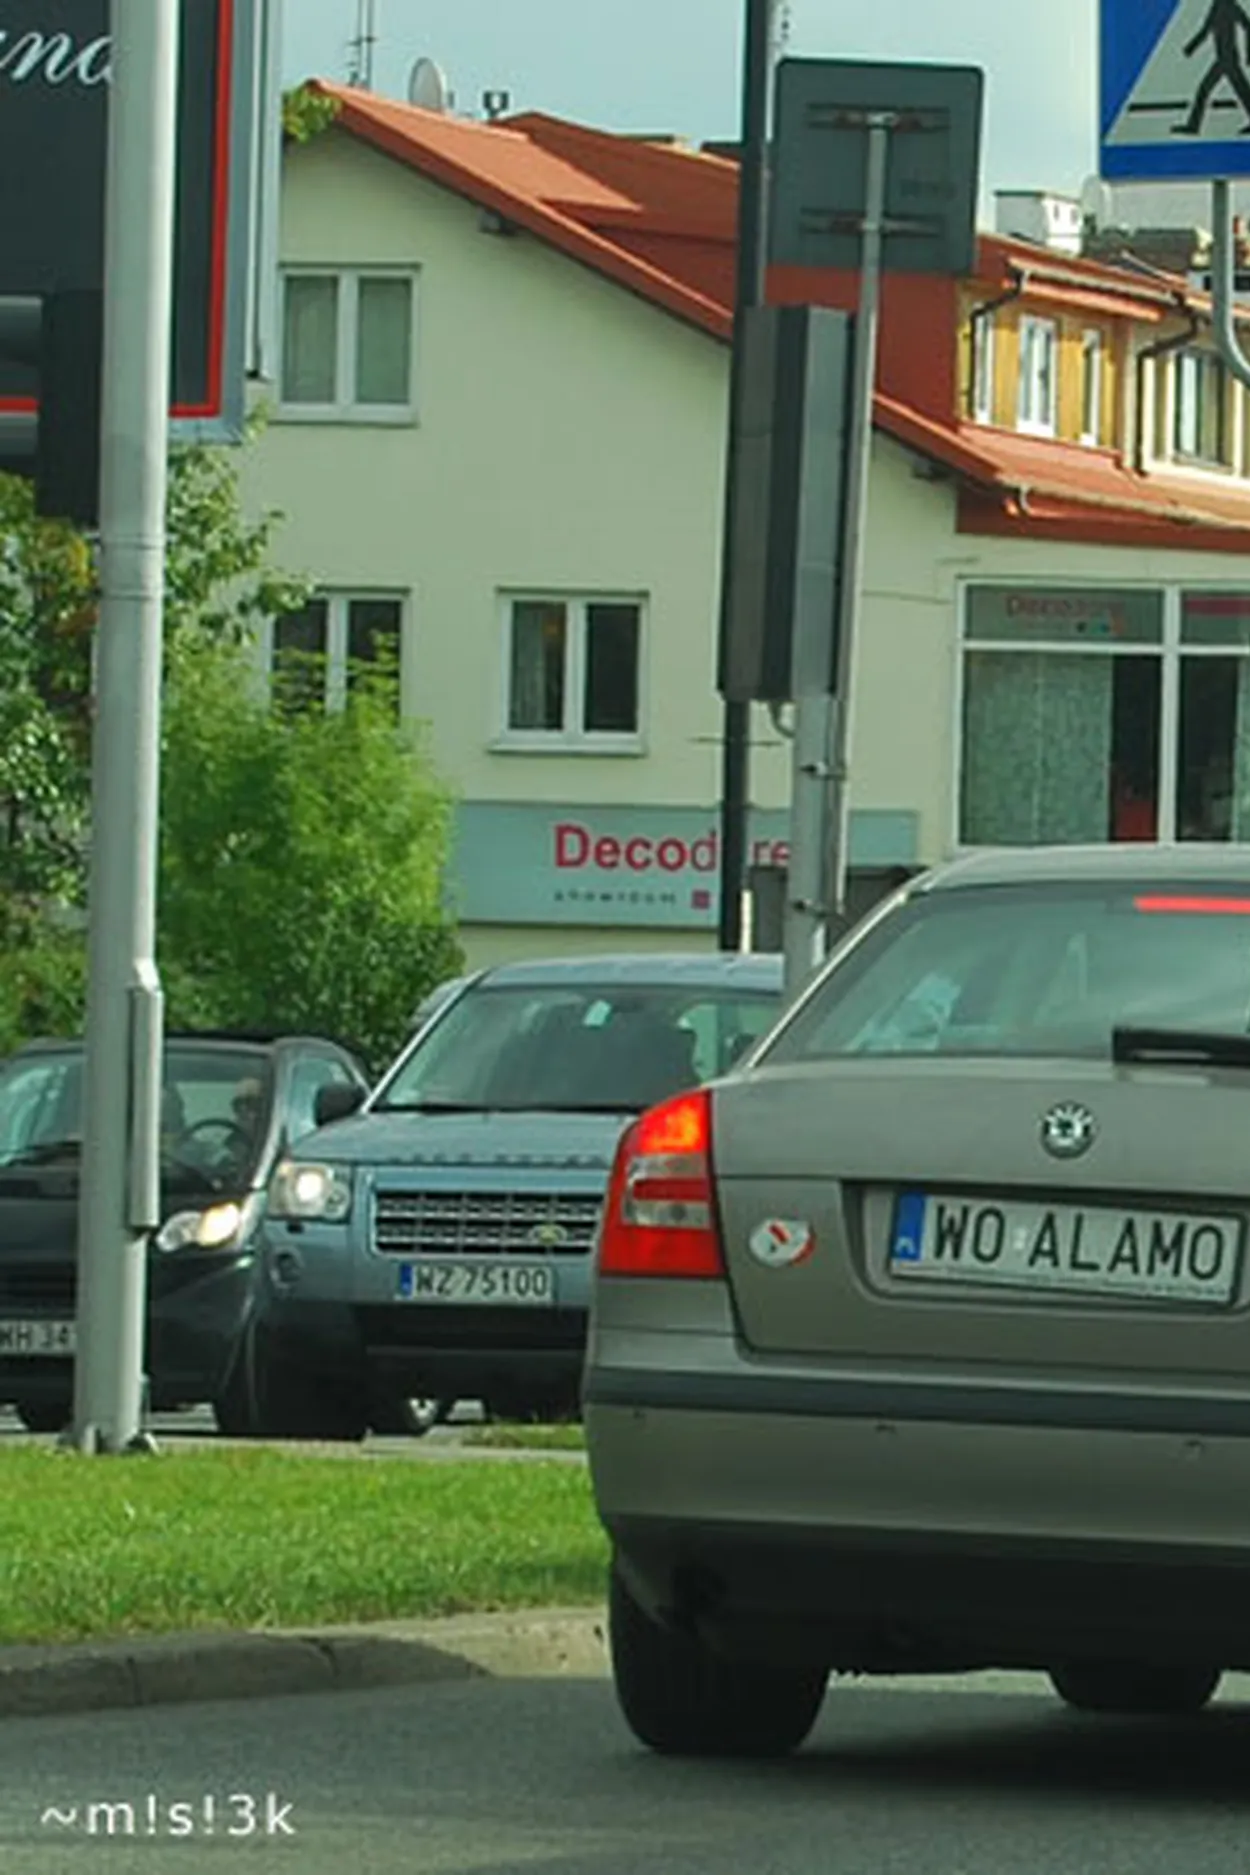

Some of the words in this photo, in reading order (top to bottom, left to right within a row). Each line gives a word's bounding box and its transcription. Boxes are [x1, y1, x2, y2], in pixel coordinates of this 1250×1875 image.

[933, 1204, 1006, 1263] WO
[1027, 1211, 1225, 1281] ALAMO
[416, 1265, 453, 1295] WZ
[463, 1266, 549, 1298] 75100
